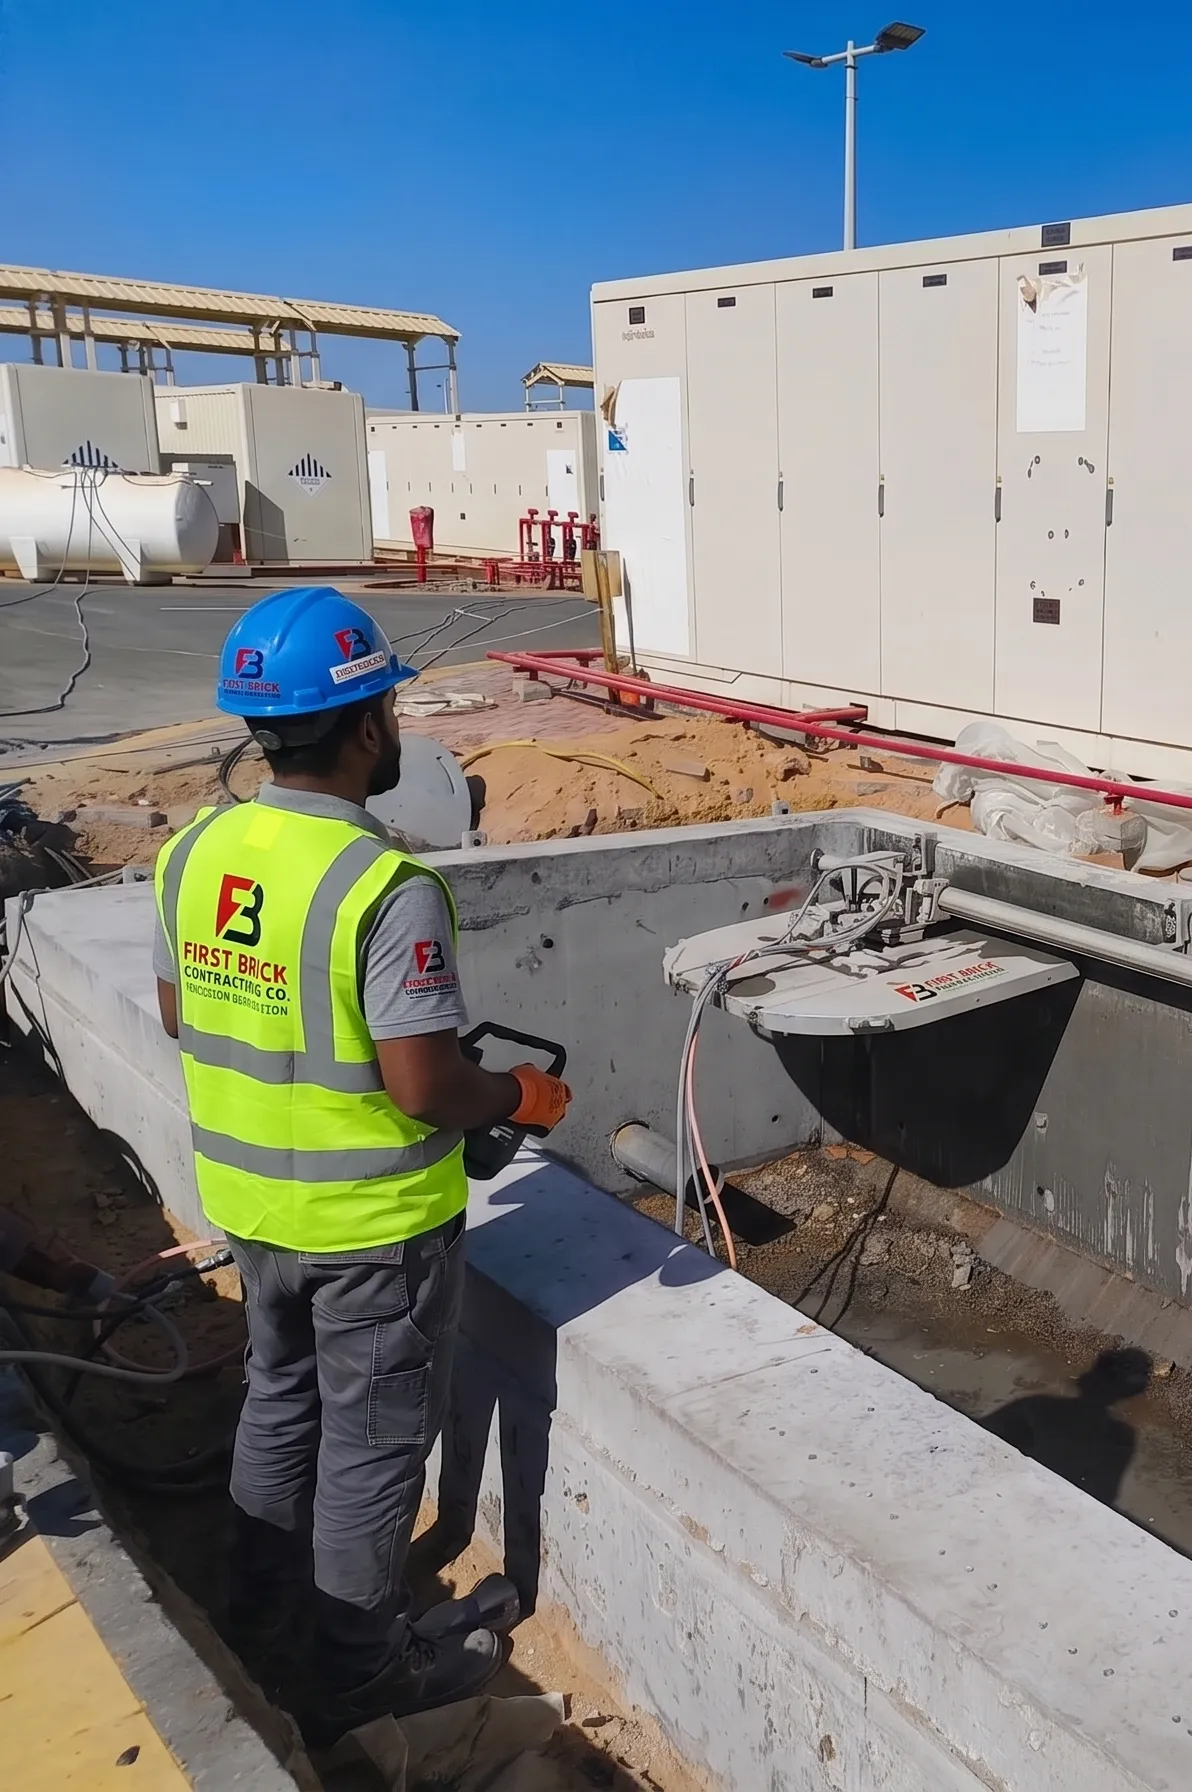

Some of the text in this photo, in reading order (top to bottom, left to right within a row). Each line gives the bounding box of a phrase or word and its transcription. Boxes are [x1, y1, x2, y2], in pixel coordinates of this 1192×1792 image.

[184, 941, 288, 985] FIRST BRICK
[265, 987, 291, 1002] CO.
